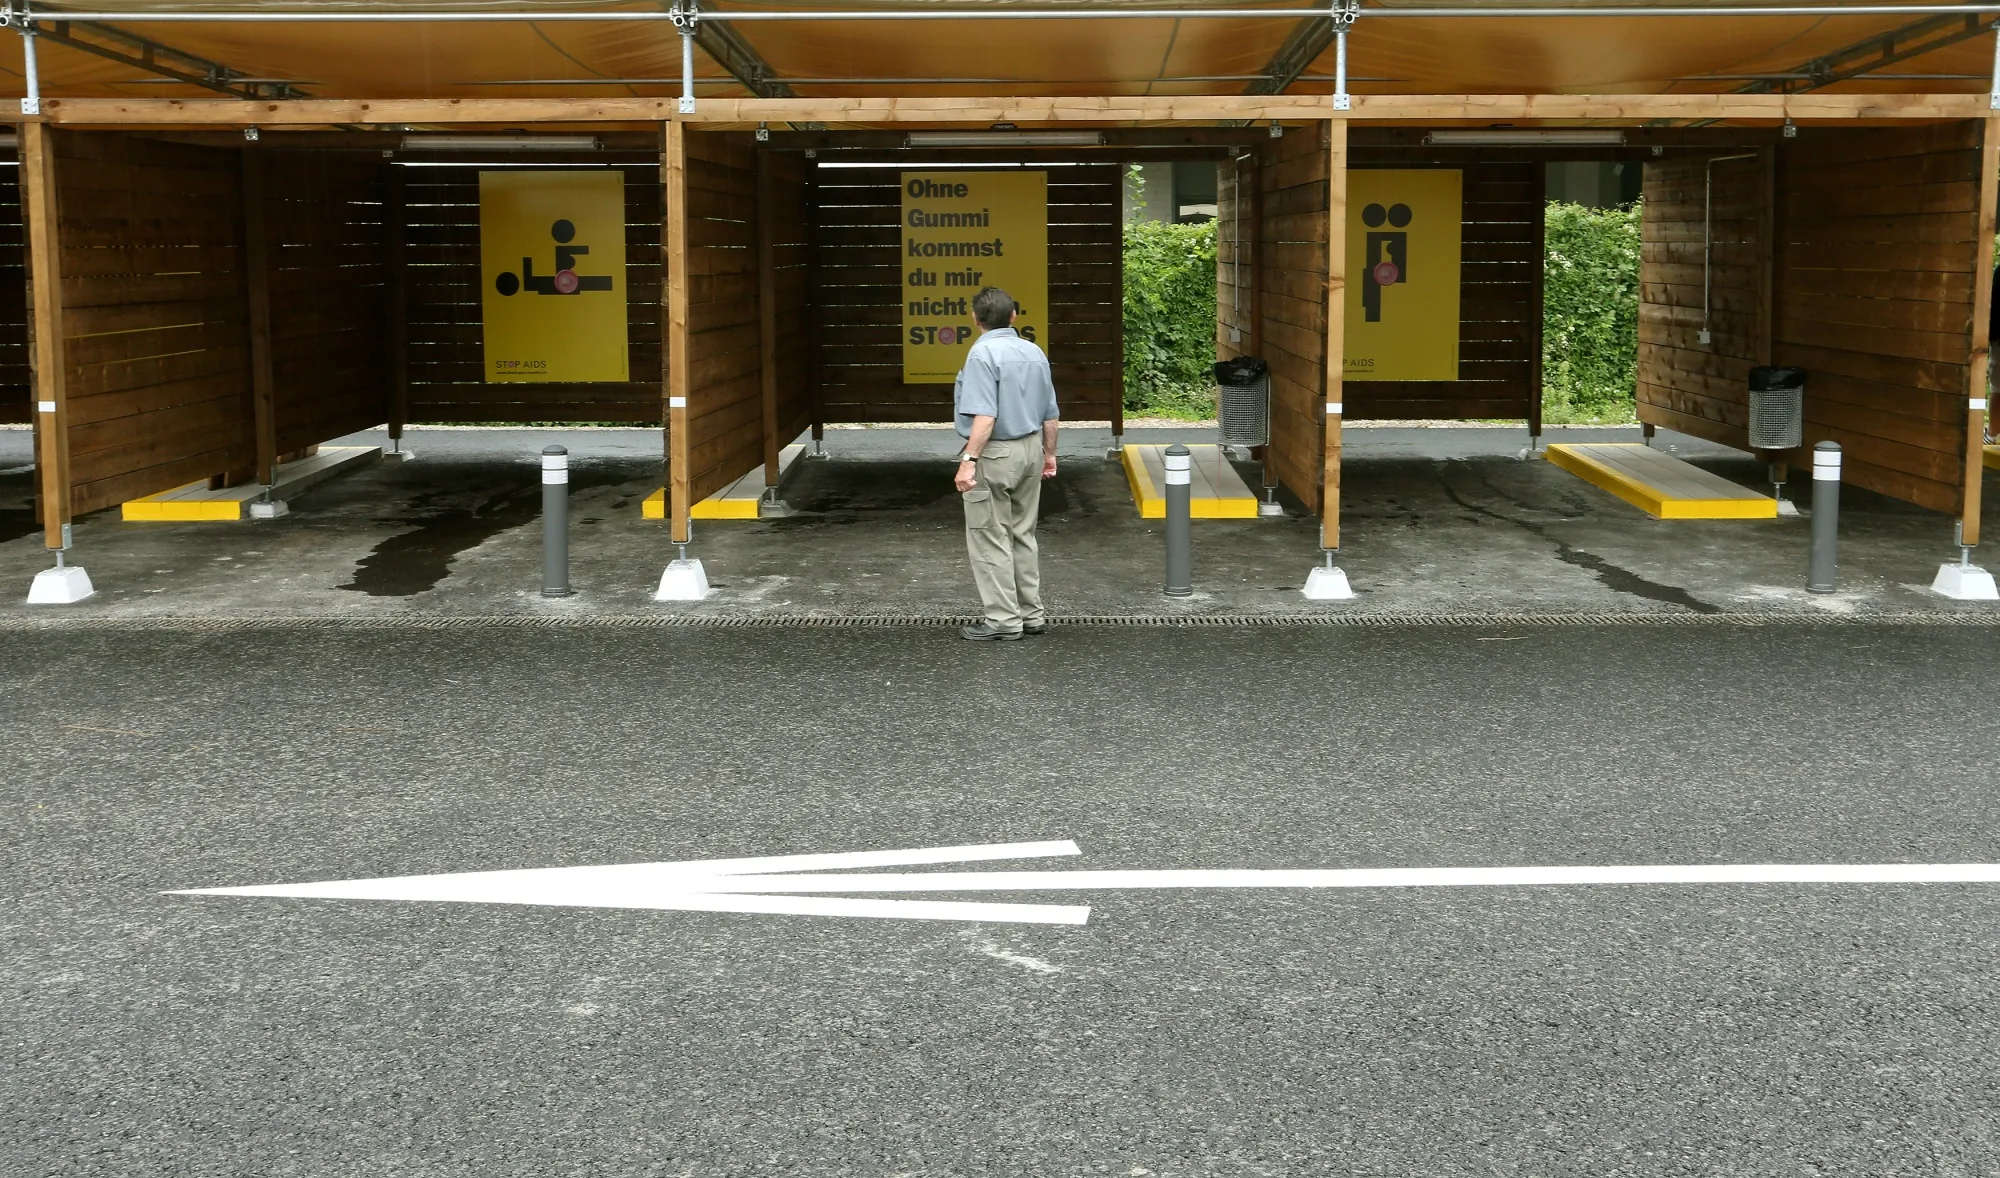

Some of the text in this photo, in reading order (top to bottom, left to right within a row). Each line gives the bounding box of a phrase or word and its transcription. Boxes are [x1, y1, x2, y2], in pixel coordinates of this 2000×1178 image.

[907, 179, 968, 198] Ohne
[908, 208, 989, 227] Gummi
[908, 238, 1003, 257] kommst
[908, 267, 982, 286] du mir
[909, 297, 967, 316] nicht
[909, 326, 972, 345] STOP
[496, 360, 547, 369] STOP AIDS
[1350, 358, 1374, 367] AIDS
